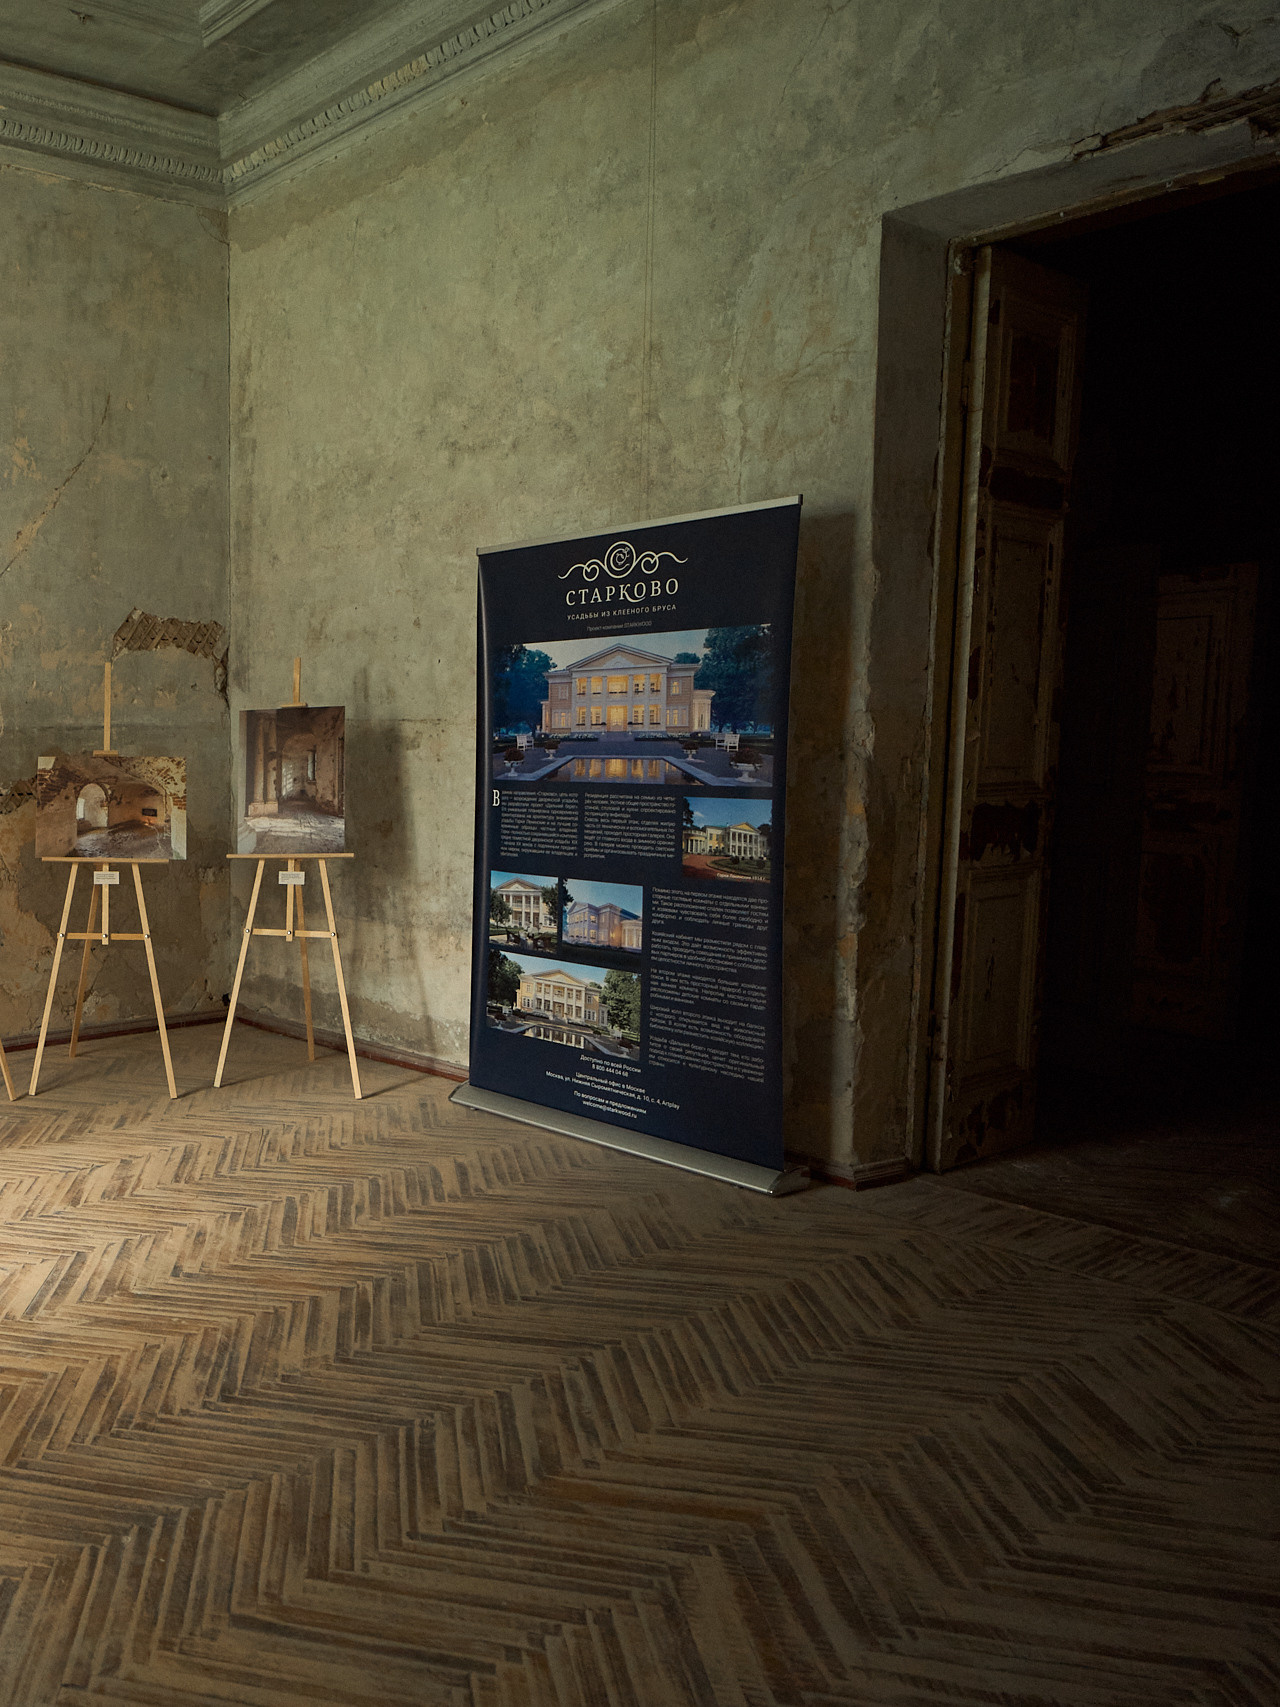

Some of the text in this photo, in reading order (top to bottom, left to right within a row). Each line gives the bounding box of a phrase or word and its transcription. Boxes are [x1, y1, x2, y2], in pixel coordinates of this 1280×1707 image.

[566, 578, 679, 606] СТАРКОВО
[567, 612, 599, 620] УСАДЬБЫ
[612, 606, 650, 616] КЛЕЕНОГО
[652, 604, 676, 612] БРУСА
[492, 789, 500, 806] В
[580, 1054, 603, 1065] Доступно
[623, 1064, 642, 1073] России
[546, 1071, 564, 1081] Москва,
[576, 1072, 608, 1084] Центральный
[609, 1080, 621, 1088] офис
[626, 1084, 646, 1094] Москве
[582, 1093, 605, 1104] вопросам
[582, 1100, 637, 1119] welcome@starkwood.ru
